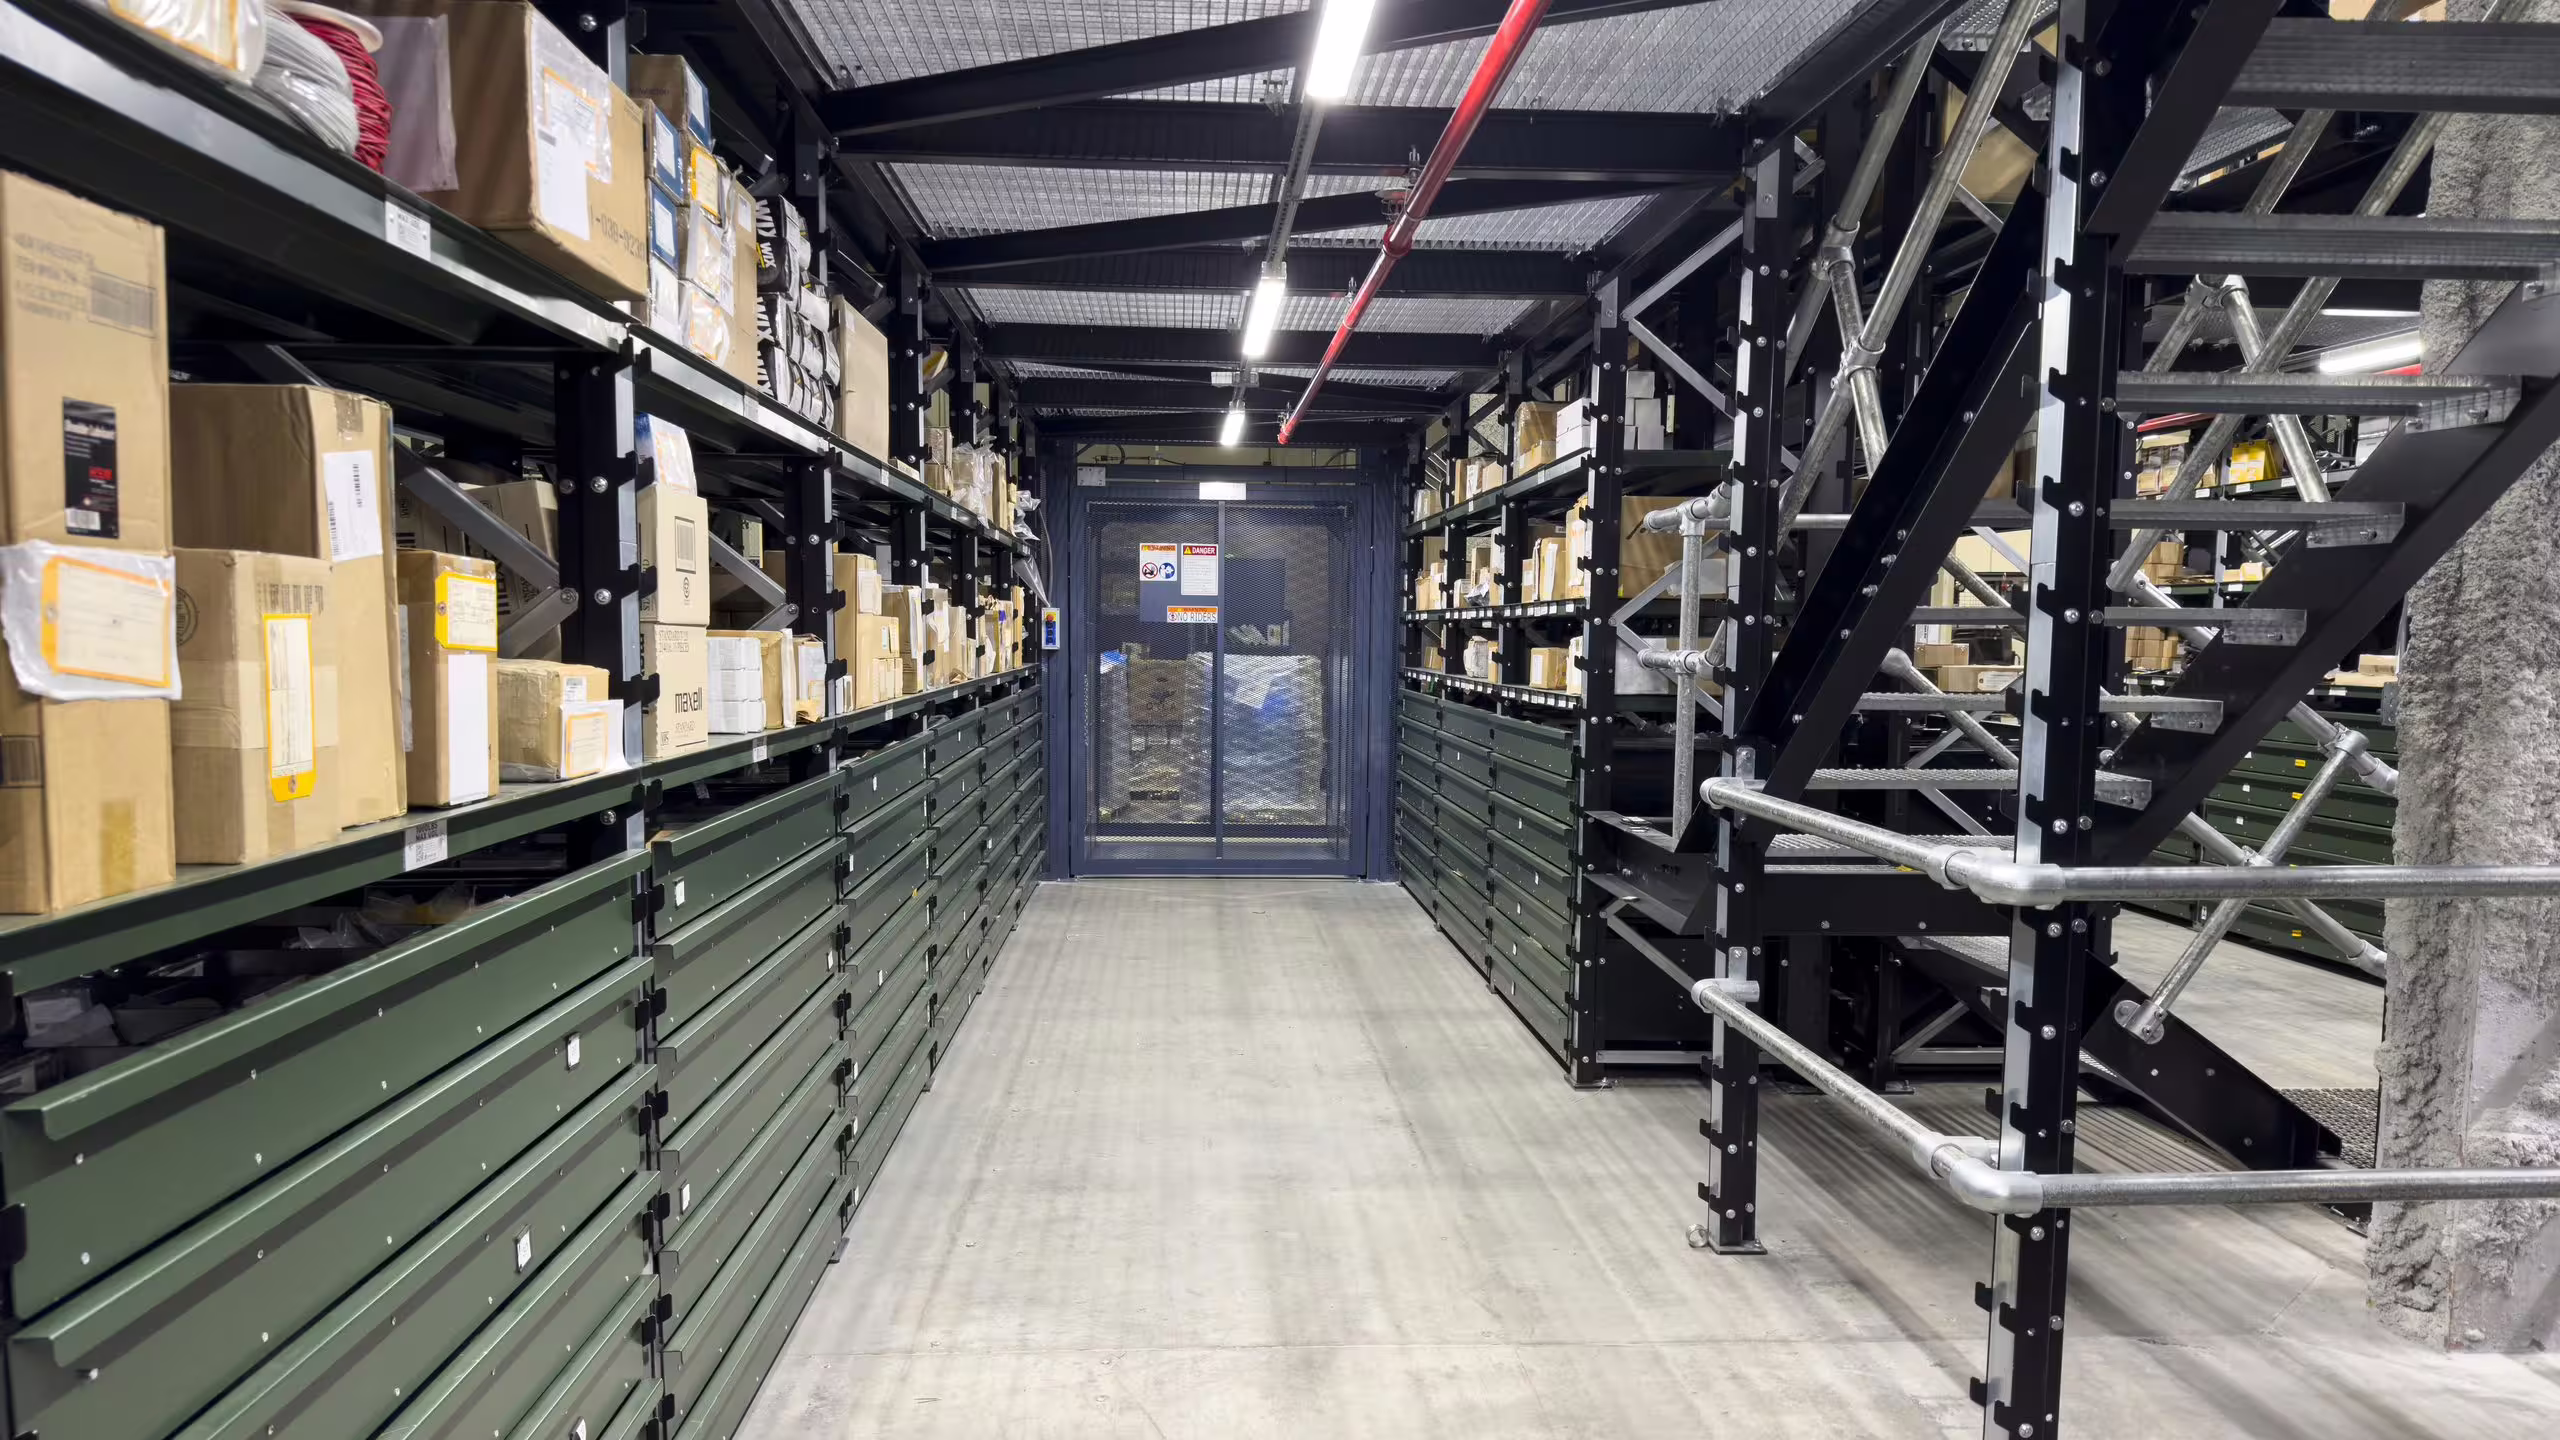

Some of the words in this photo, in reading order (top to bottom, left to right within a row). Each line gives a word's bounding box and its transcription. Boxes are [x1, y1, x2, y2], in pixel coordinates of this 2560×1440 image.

[756, 200, 777, 237] WIX
[759, 242, 776, 268] WIX
[757, 297, 775, 342] WIX
[1177, 612, 1188, 622] NO
[1190, 612, 1217, 622] RIDERS
[675, 686, 703, 714] maxell
